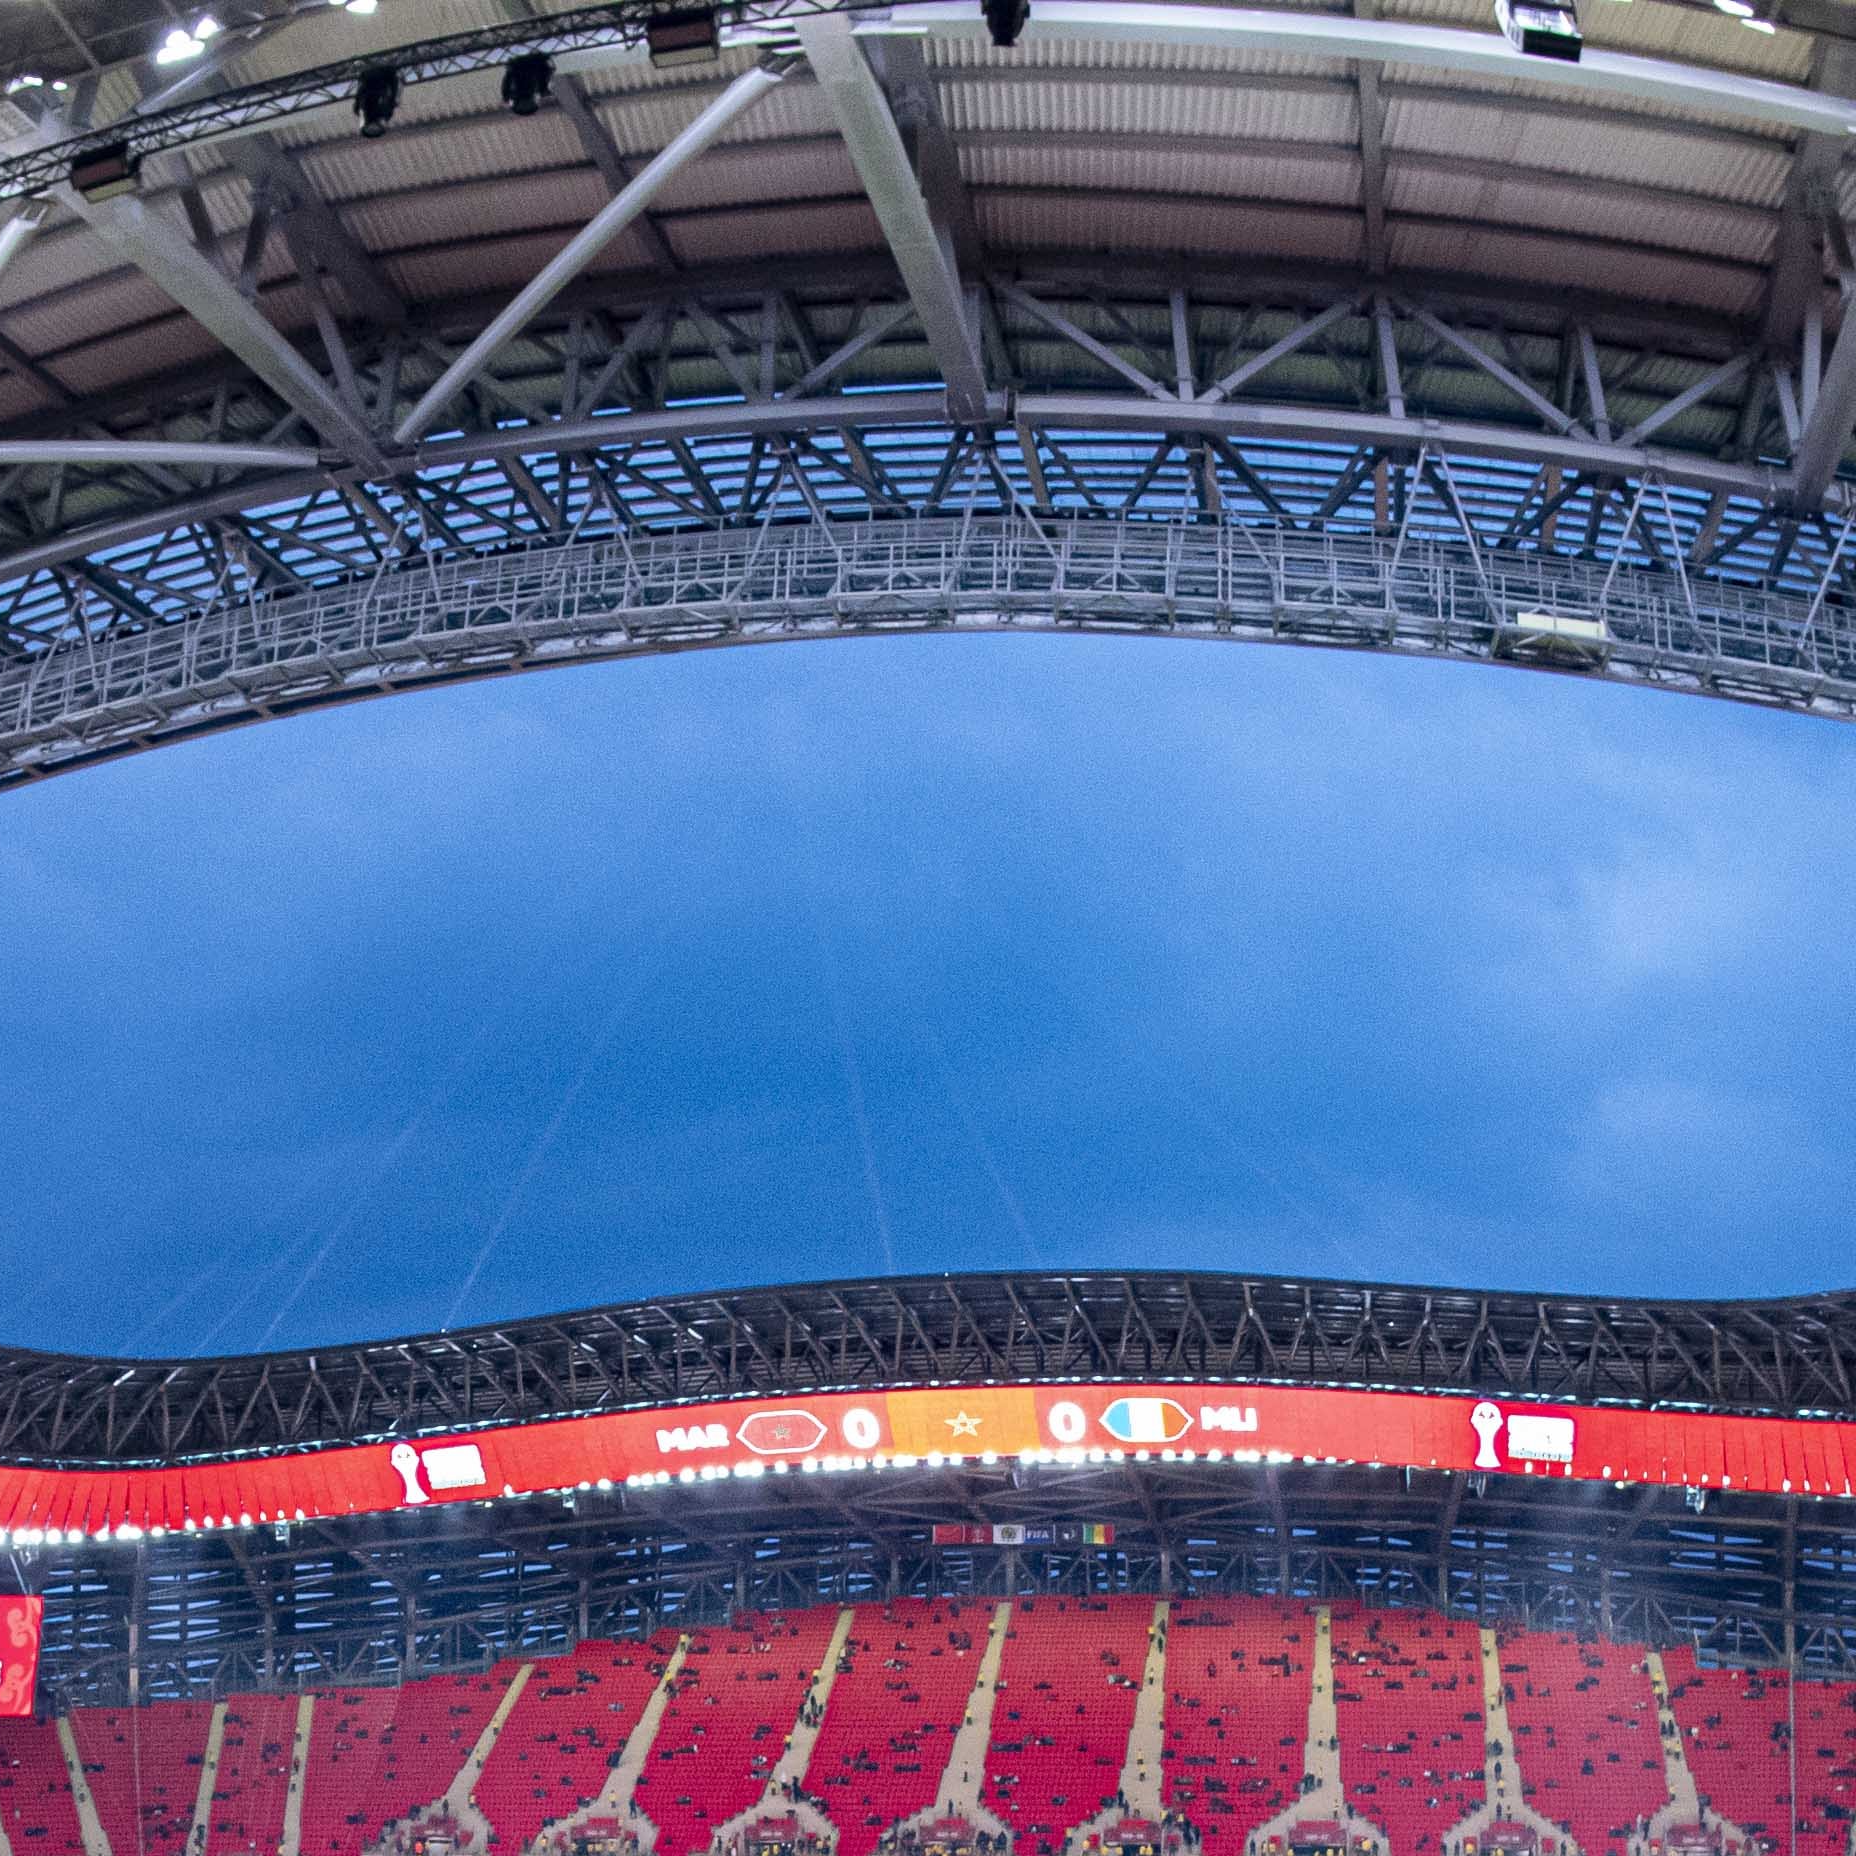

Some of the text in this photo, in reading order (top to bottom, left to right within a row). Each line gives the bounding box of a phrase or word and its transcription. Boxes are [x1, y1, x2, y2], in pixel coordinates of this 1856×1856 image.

[656, 1408, 881, 1454] MAR 0
[1048, 1401, 1086, 1443] 0
